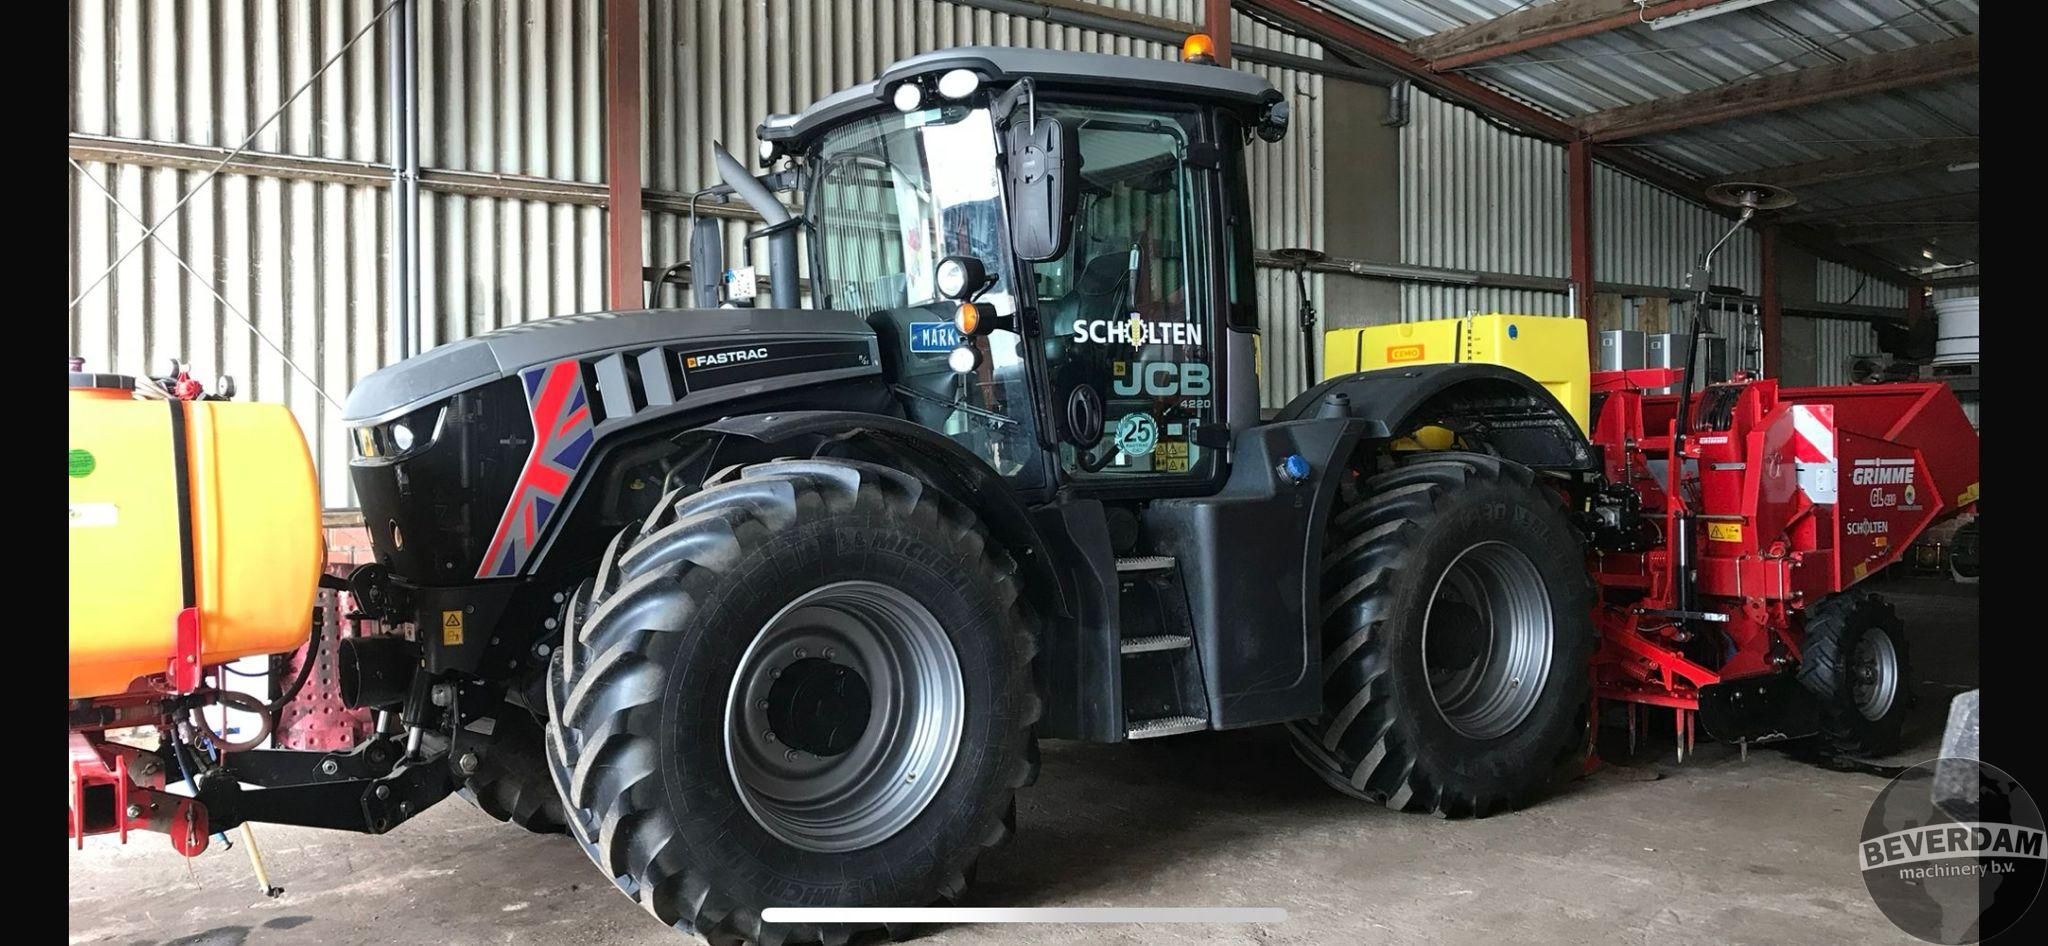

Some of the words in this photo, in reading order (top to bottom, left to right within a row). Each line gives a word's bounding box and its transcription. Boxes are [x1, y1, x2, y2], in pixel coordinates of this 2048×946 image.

[696, 347, 769, 367] FASTRAC
[1113, 362, 1211, 396] JCB
[1180, 400, 1211, 408] 4220
[1124, 420, 1151, 442] 25
[1852, 466, 1915, 486] GRIMME
[1846, 520, 1889, 535] SCHOLTEN
